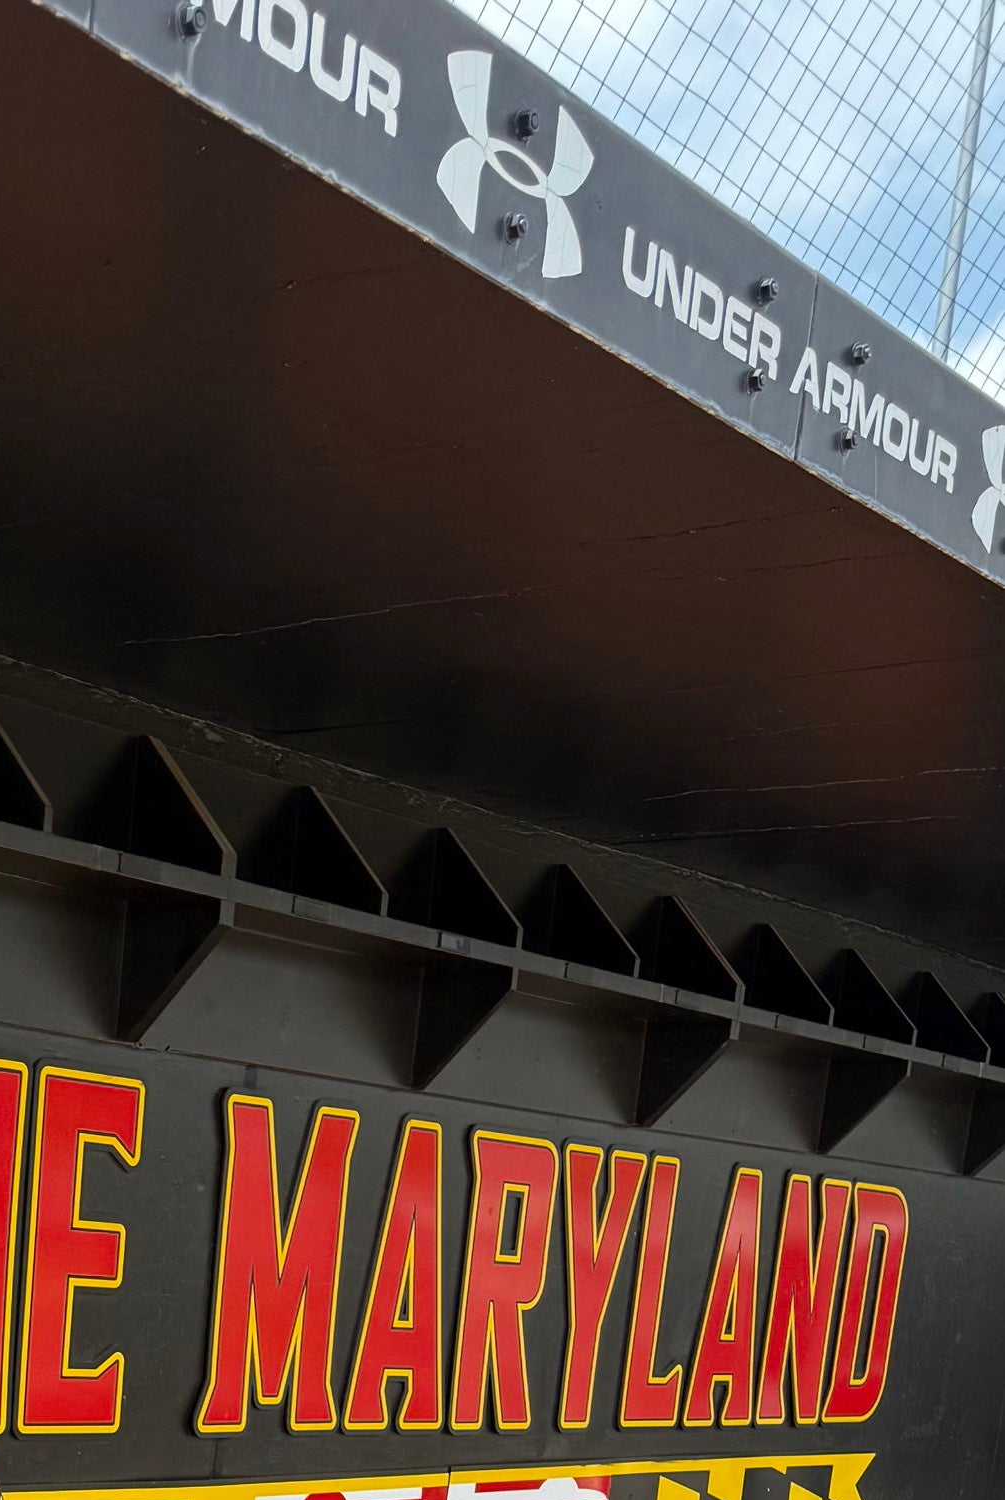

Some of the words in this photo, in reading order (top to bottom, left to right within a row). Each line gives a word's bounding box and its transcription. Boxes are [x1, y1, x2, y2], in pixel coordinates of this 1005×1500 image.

[622, 226, 781, 380] UNDER
[789, 347, 958, 493] ARMOUR
[197, 1094, 908, 1431] MARYLAND
